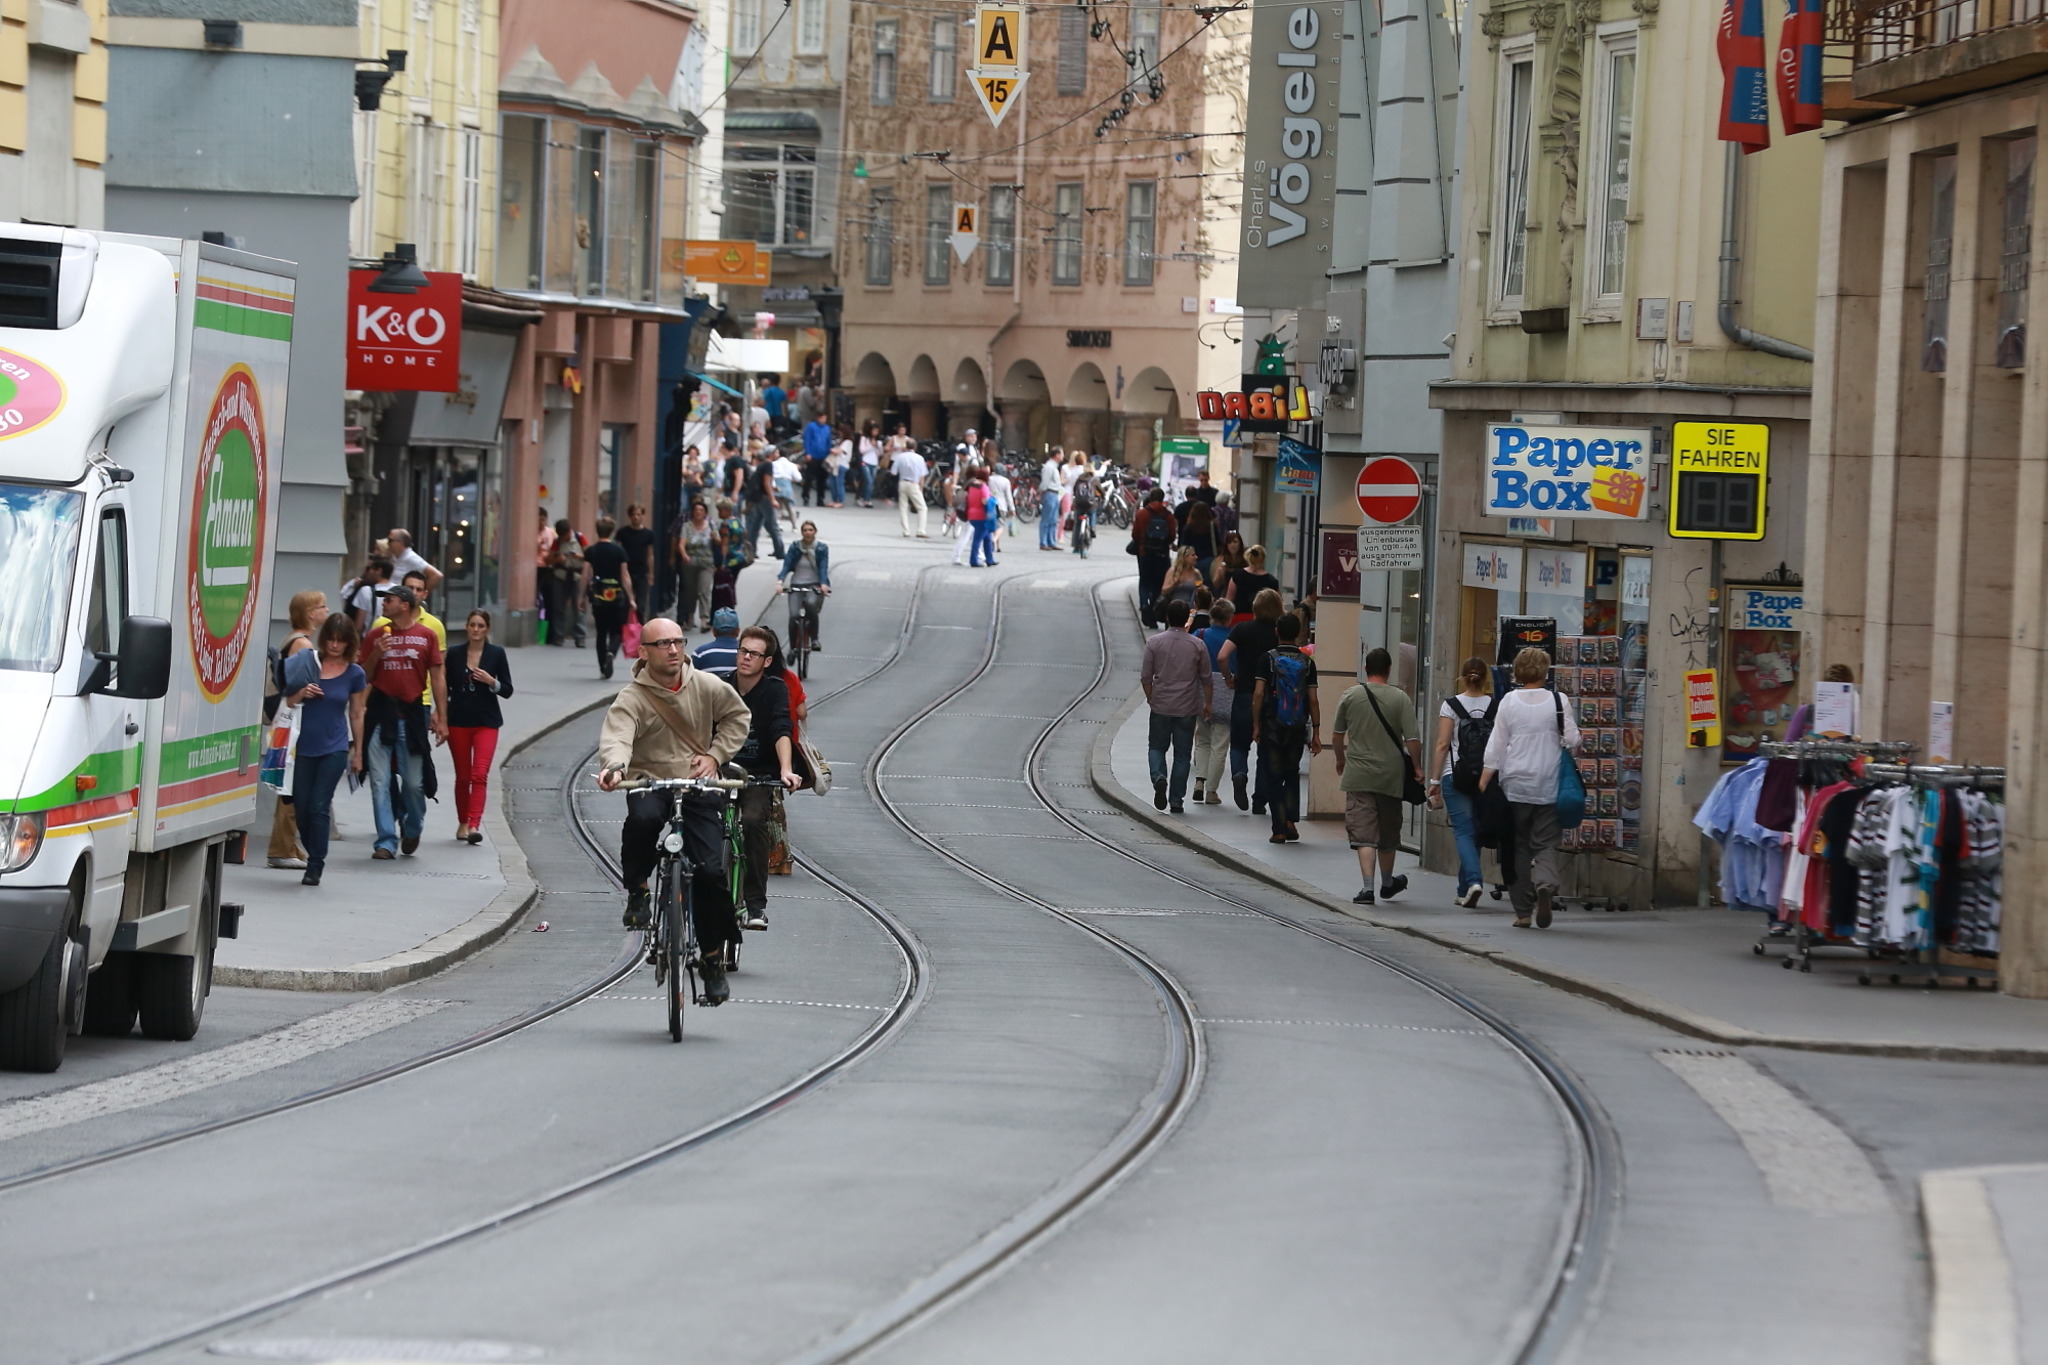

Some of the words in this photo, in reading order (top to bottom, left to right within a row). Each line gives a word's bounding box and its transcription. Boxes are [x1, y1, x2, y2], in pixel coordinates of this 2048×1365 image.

[984, 15, 1014, 60] A
[985, 79, 1008, 103] 15
[1266, 6, 1323, 249] Vögele
[1317, 6, 1343, 254] Switzerland
[957, 209, 973, 232] A
[356, 304, 446, 346] K&O
[363, 353, 436, 367] HOME
[1706, 428, 1735, 446] SIE
[1492, 427, 1642, 477] Paper
[1679, 449, 1760, 468] FAHREN
[1490, 469, 1592, 512] Box
[1747, 611, 1793, 628] Box
[1524, 630, 1543, 642] 16
